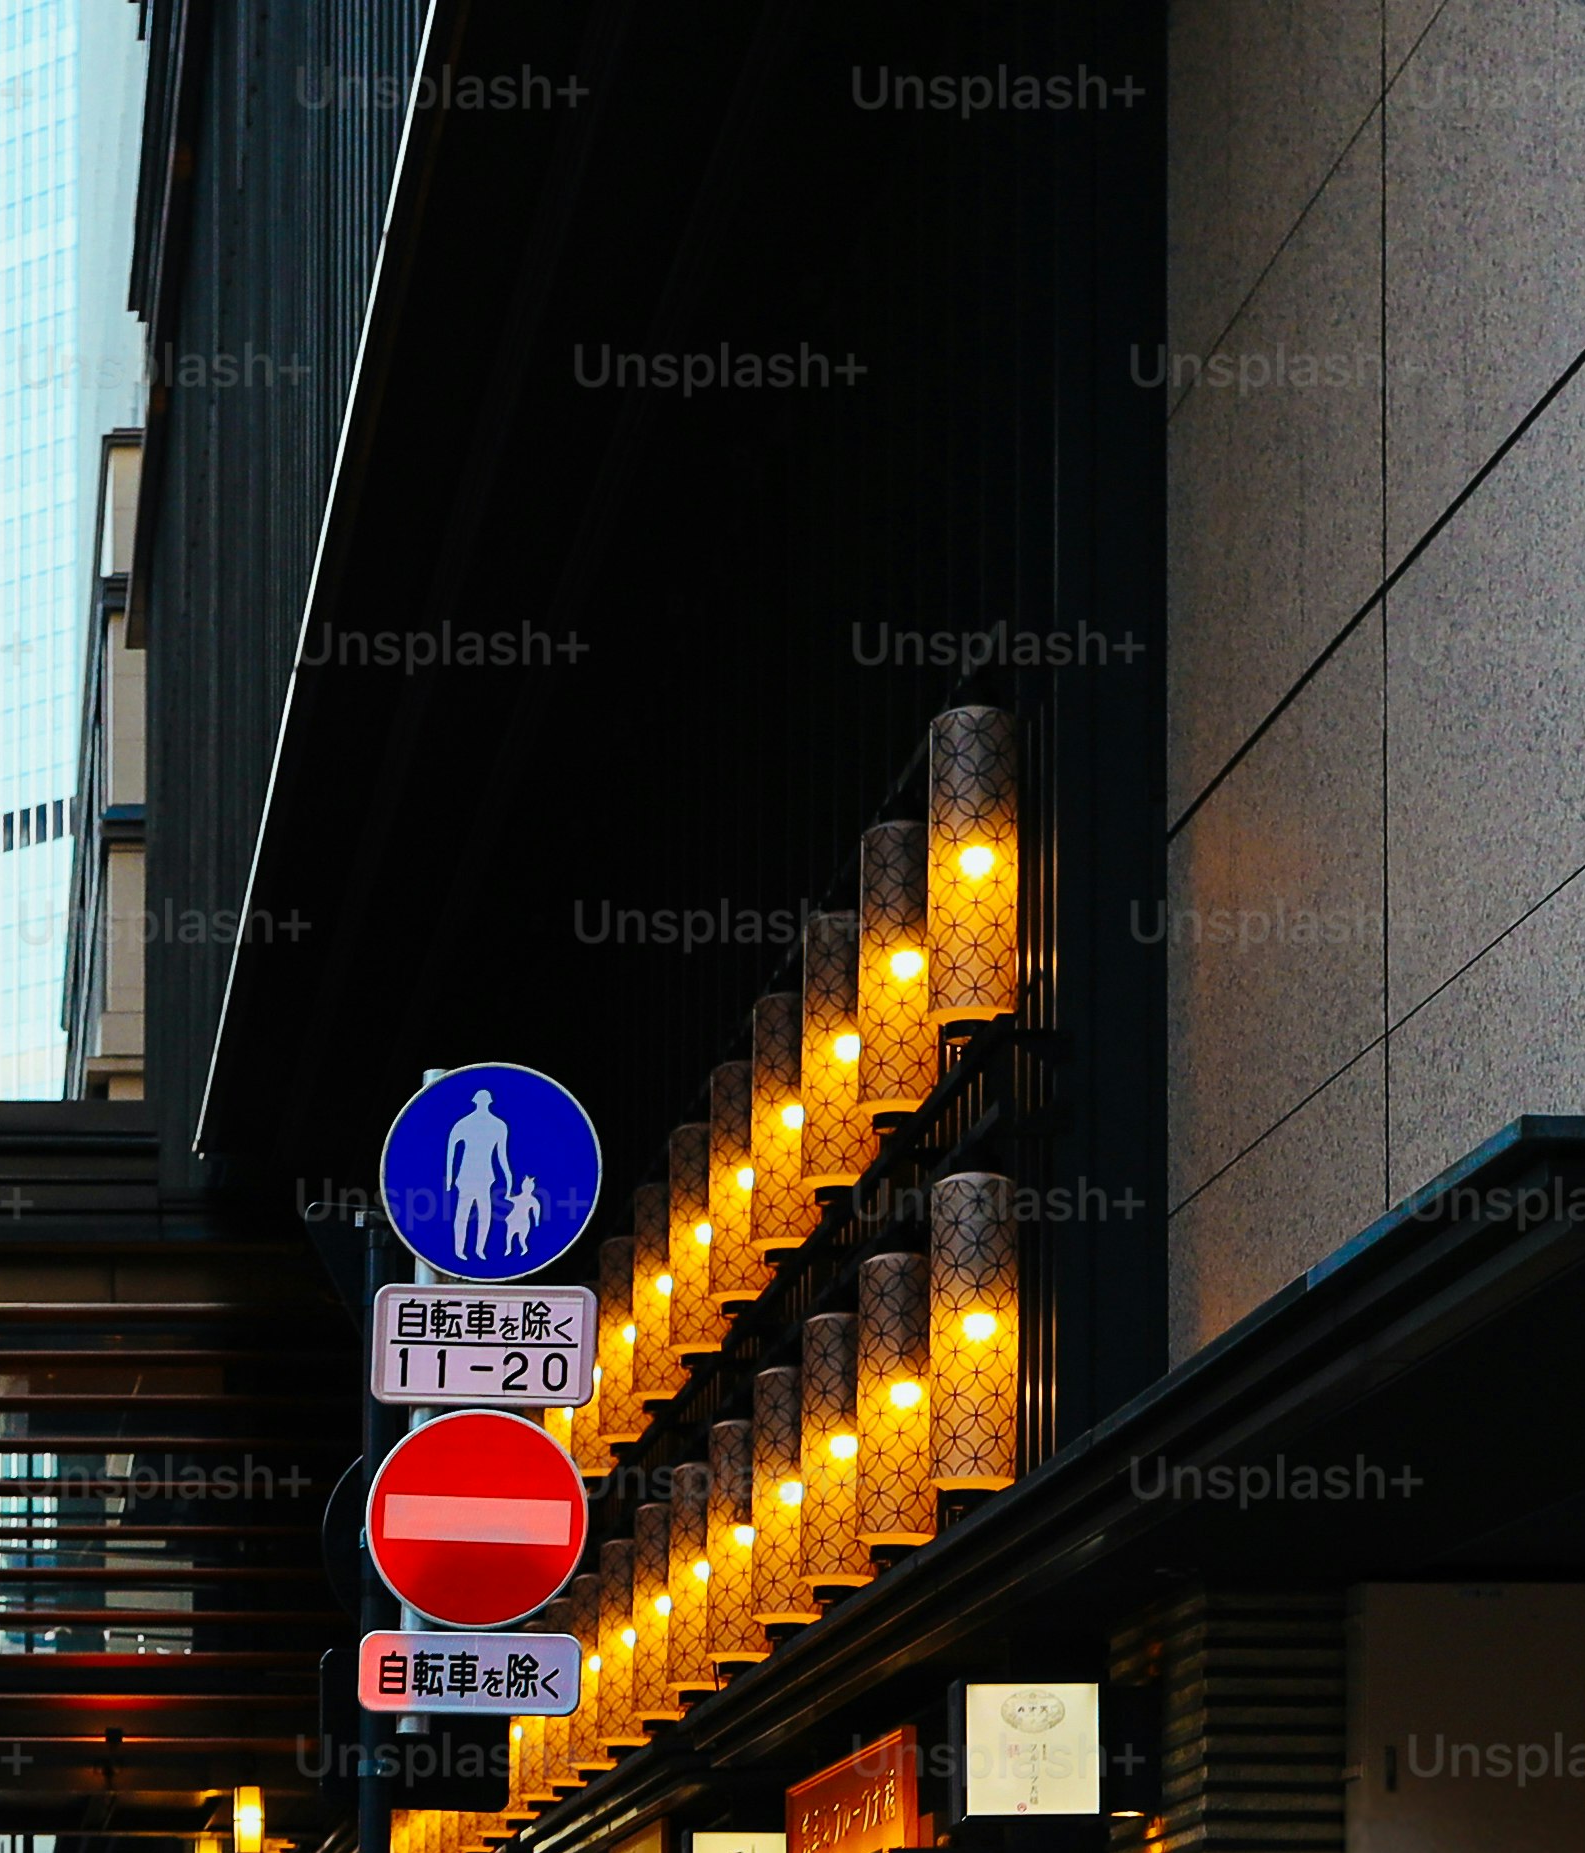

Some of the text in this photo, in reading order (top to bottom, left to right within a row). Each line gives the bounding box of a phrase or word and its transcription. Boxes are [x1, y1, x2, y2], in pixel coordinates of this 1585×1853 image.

[396, 1300, 574, 1342] 自転車を除く
[396, 1347, 570, 1392] 11-20
[377, 1651, 561, 1701] 自転車を除く
